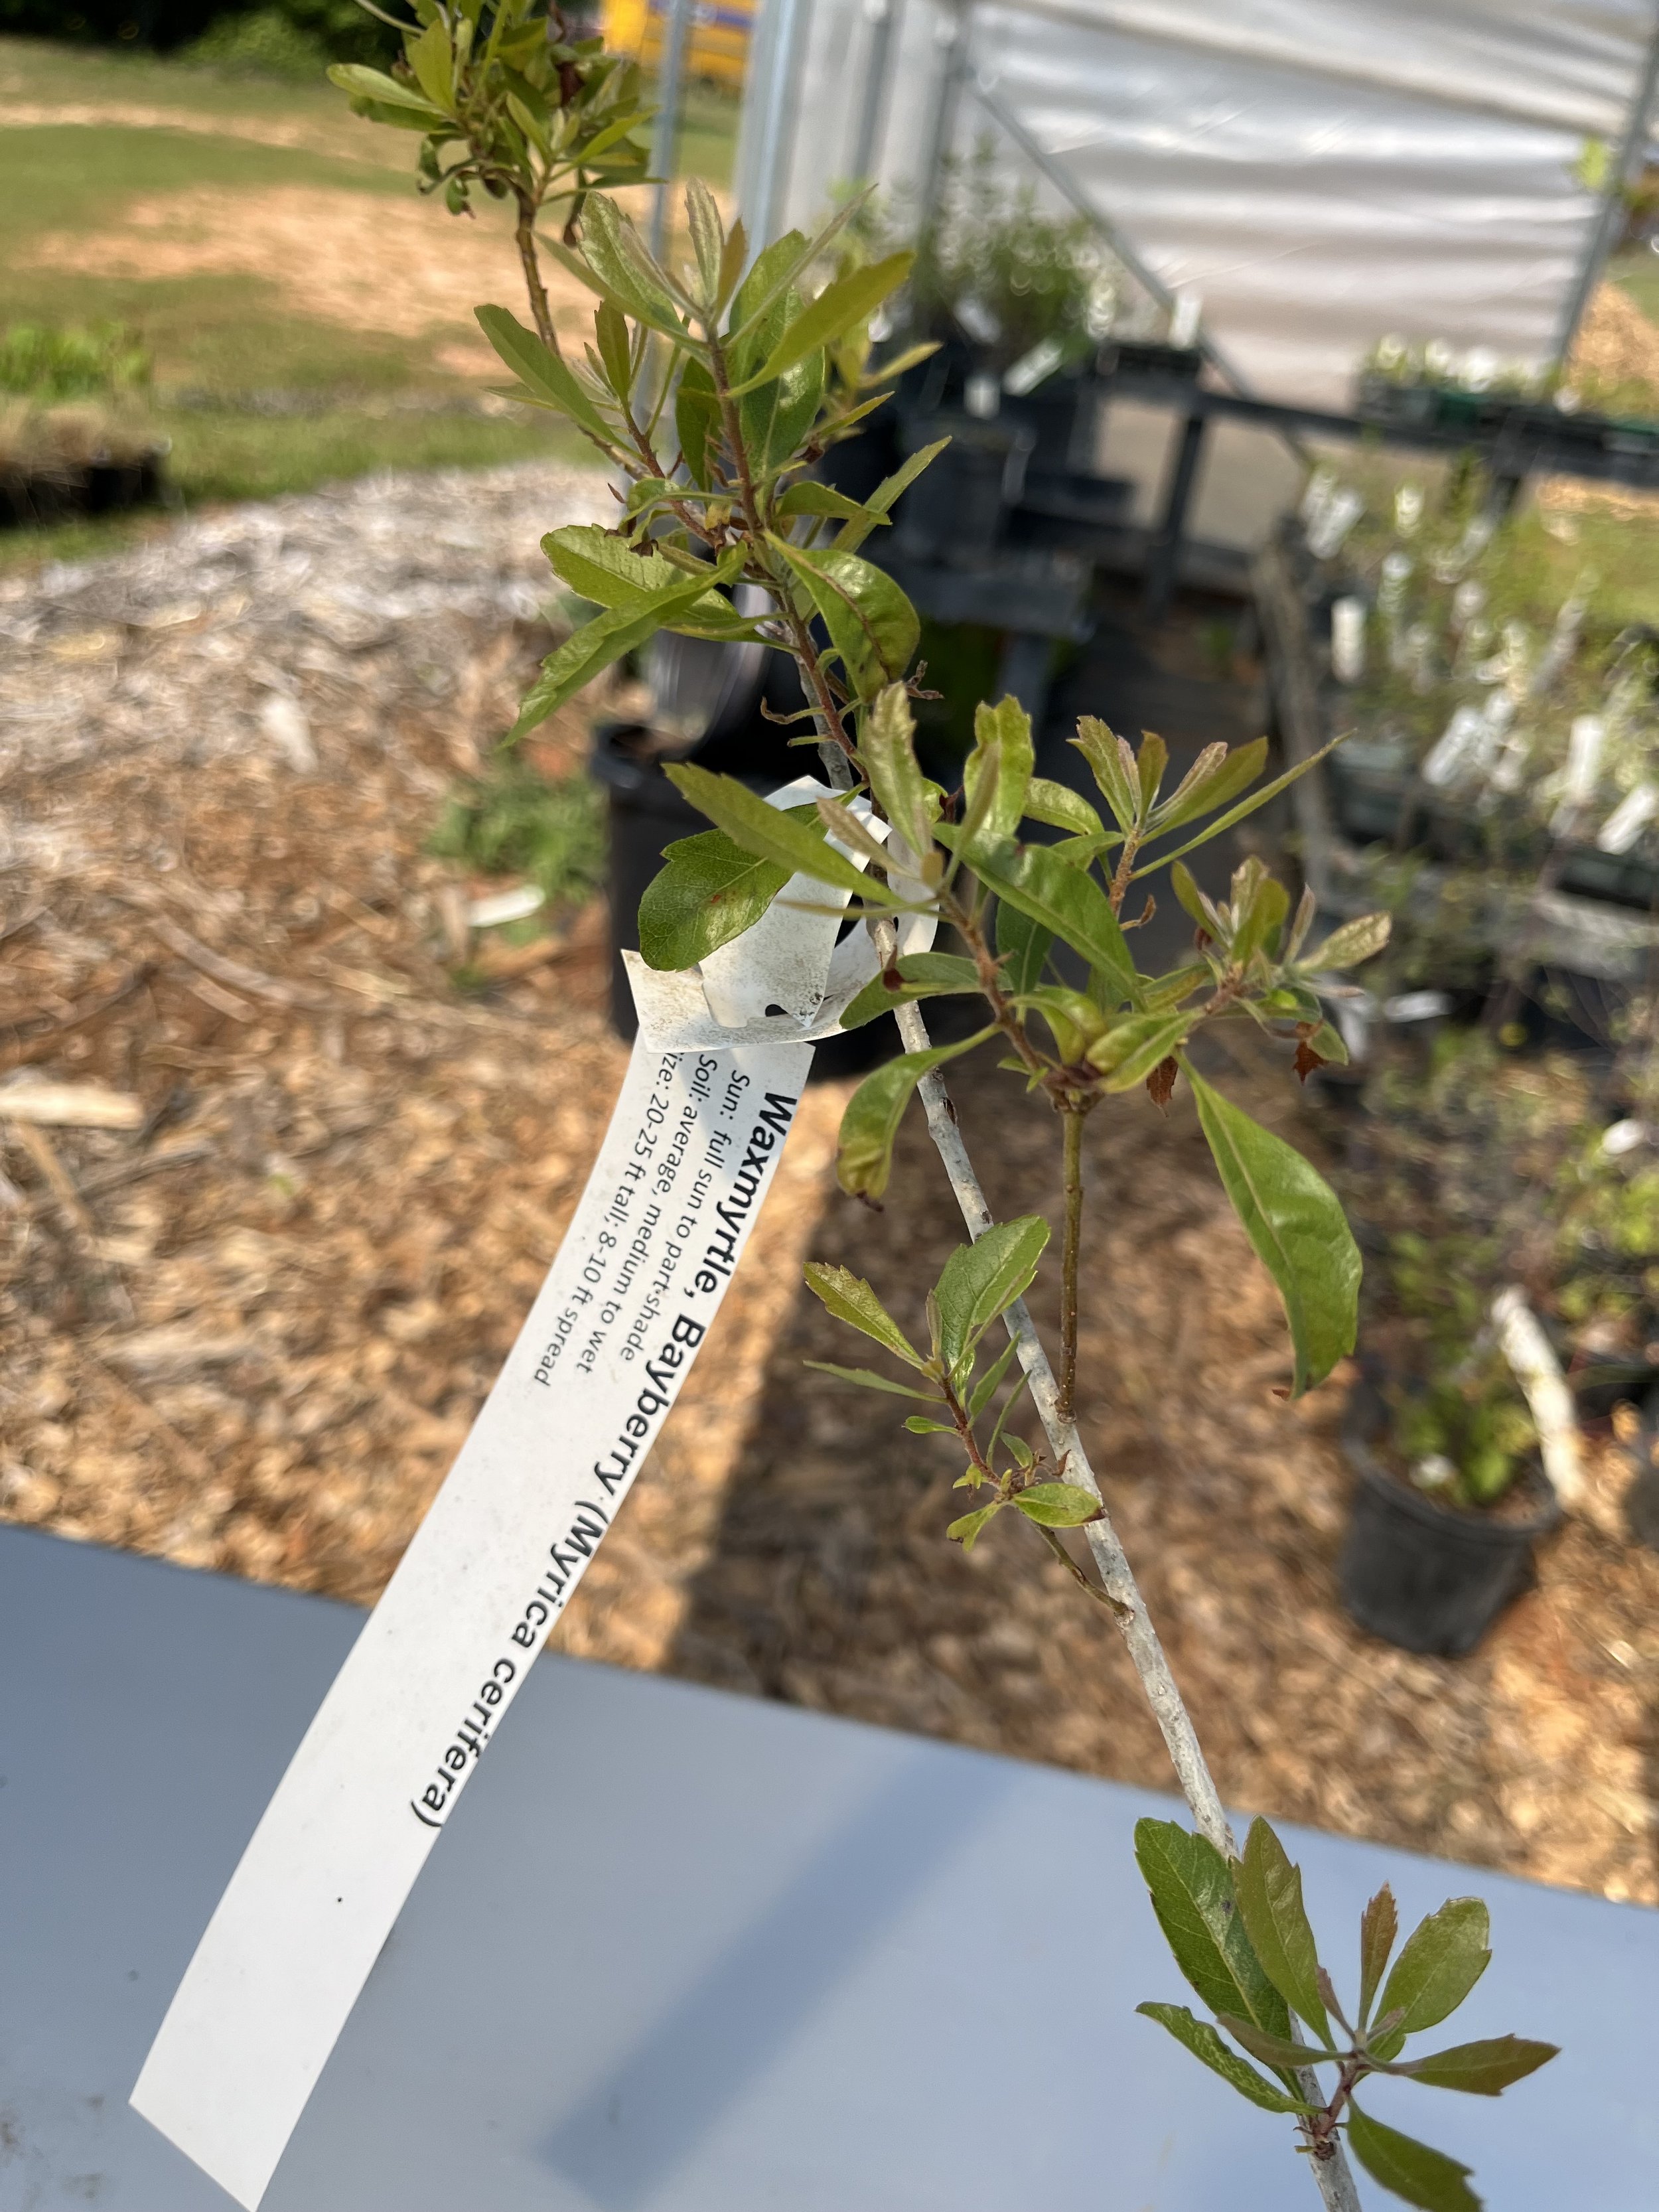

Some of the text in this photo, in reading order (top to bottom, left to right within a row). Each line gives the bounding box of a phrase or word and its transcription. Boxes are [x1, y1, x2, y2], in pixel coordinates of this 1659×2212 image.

[719, 1069, 751, 1120] Sun:
[703, 1130, 733, 1169] full
[576, 1053, 718, 1374] Soil: average, medium to wet
[687, 1169, 713, 1210] sun
[534, 1052, 685, 1386] ize: 20-25 ft tall; 8-10 ft spread
[676, 1215, 698, 1239] to
[410, 1091, 798, 1828] Waxmyrtle, Bayberry (Myrica cerifera)
